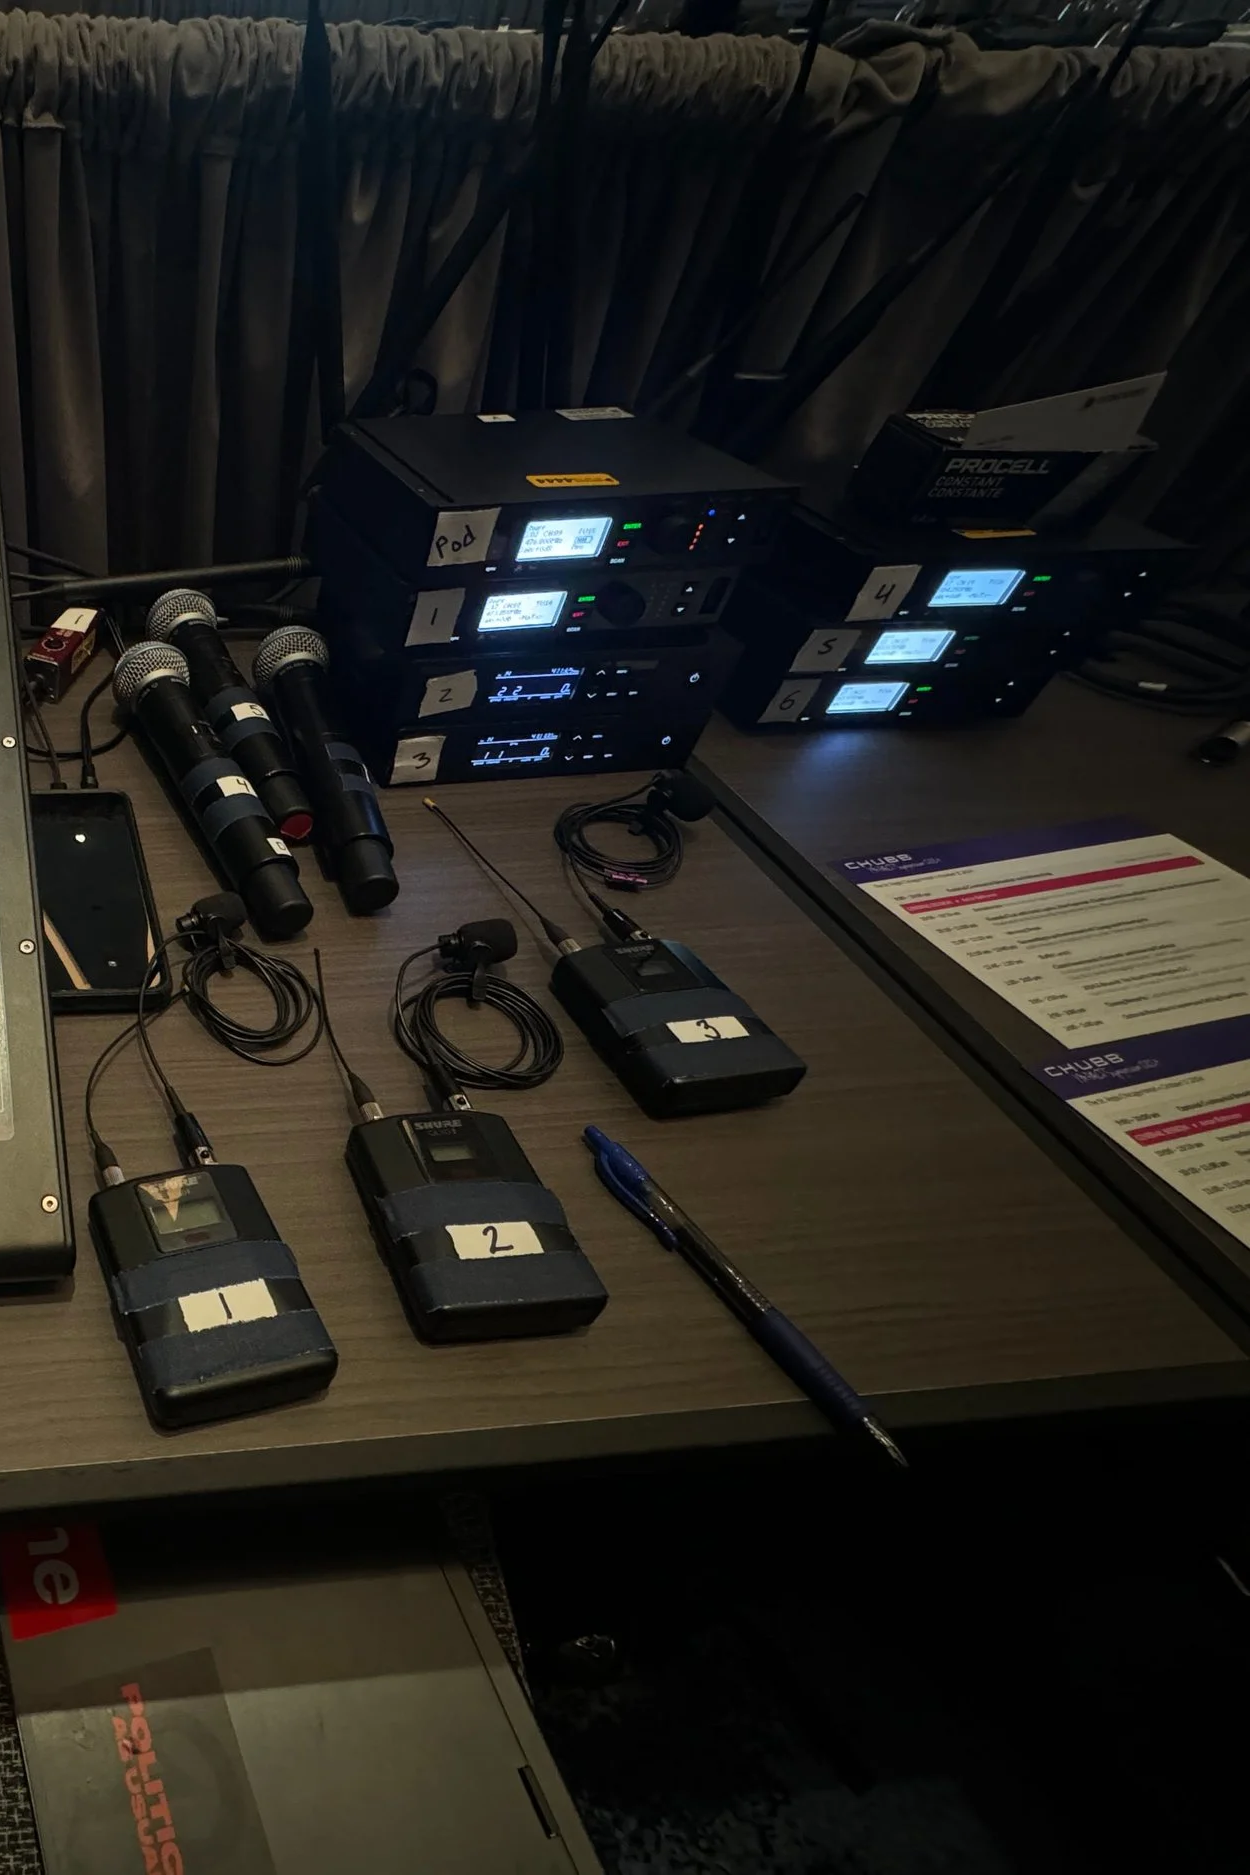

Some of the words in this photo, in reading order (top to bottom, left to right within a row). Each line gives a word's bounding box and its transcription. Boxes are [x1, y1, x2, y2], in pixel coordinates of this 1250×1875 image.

[944, 457, 1050, 475] PROCELL
[935, 476, 1006, 488] CONSTANT
[927, 487, 1005, 499] CONSTANTE
[435, 525, 476, 559] Pod
[874, 584, 896, 604] 4
[430, 608, 438, 626] 1
[818, 638, 837, 655] 5
[780, 690, 800, 710] 6
[249, 705, 264, 716] 5
[414, 752, 431, 769] 3
[237, 778, 250, 792] 4
[844, 853, 912, 870] CHUBB
[696, 1020, 721, 1039] 3
[1044, 1053, 1124, 1077] CHUBB
[414, 1119, 462, 1130] SHURE
[482, 1226, 514, 1254] 2
[218, 1292, 232, 1319] 1
